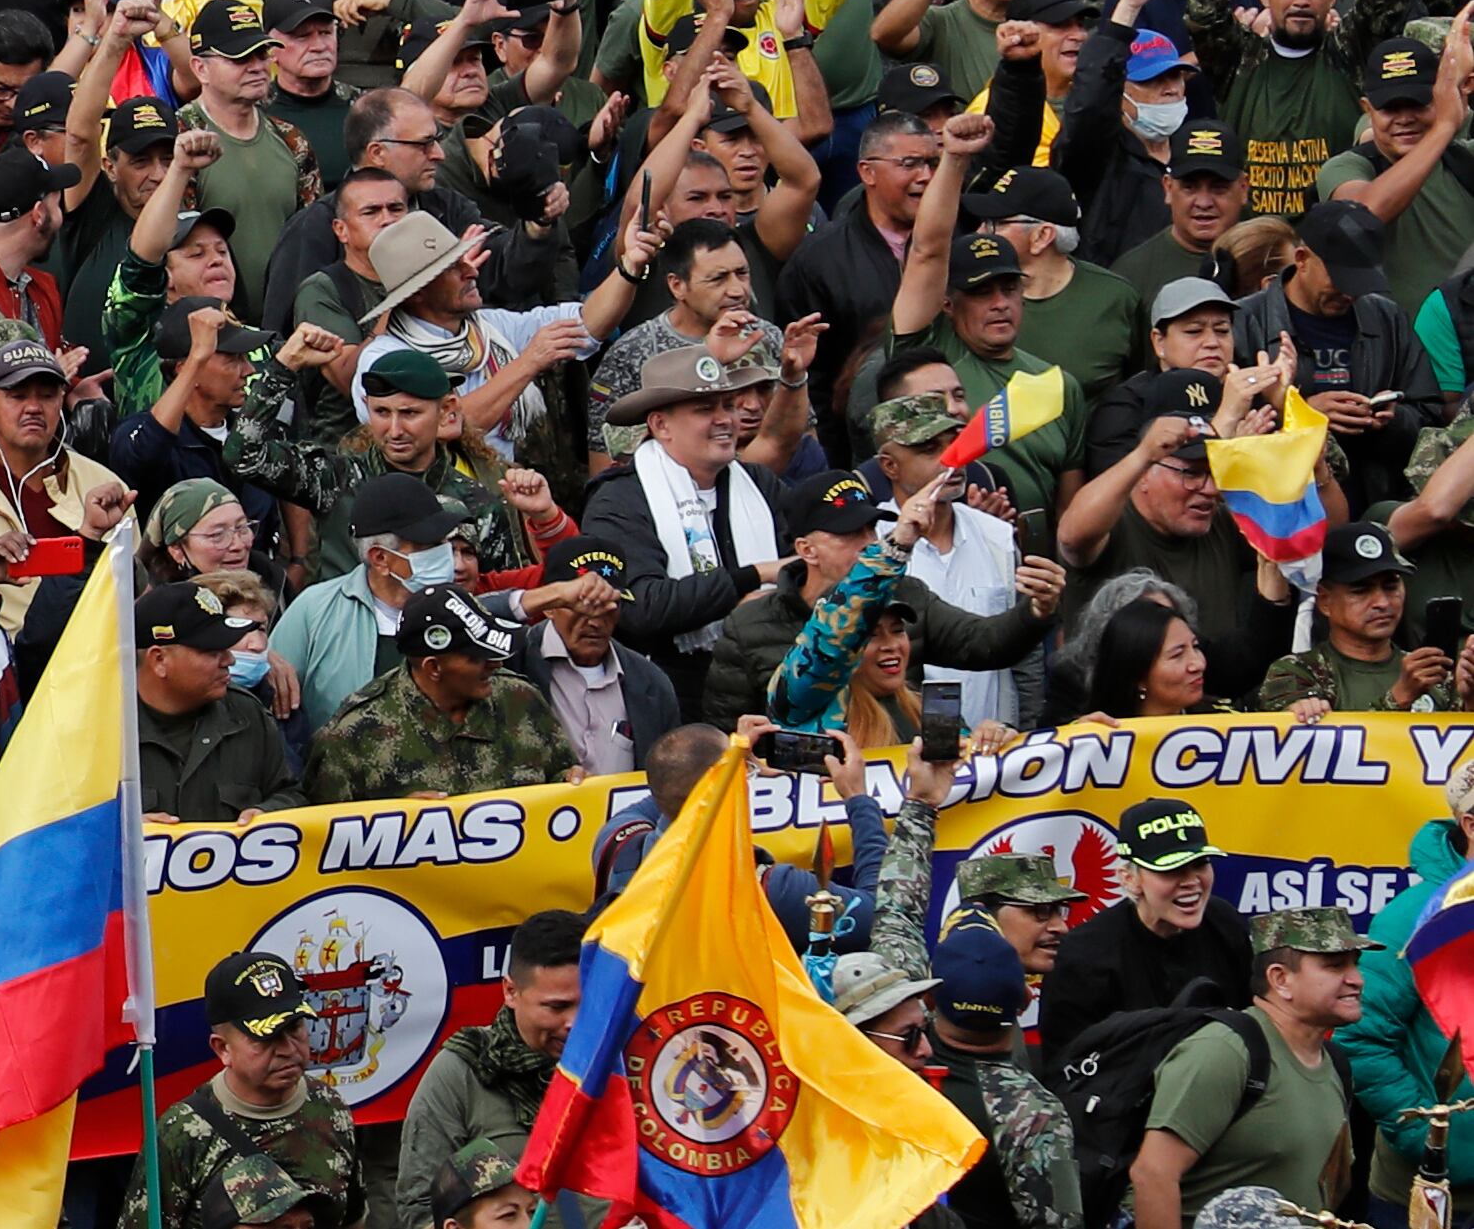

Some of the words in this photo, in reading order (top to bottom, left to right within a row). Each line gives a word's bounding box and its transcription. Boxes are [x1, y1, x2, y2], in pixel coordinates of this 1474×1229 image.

[1292, 137, 1330, 160] ACTIVA
[1185, 382, 1210, 407] NY
[569, 551, 625, 571] VETERANO
[1153, 725, 1391, 787] CIVIL
[1409, 725, 1473, 786] Y
[320, 798, 527, 873] MAS
[1237, 863, 1327, 916] ASÍ
[1331, 871, 1394, 916] SE
